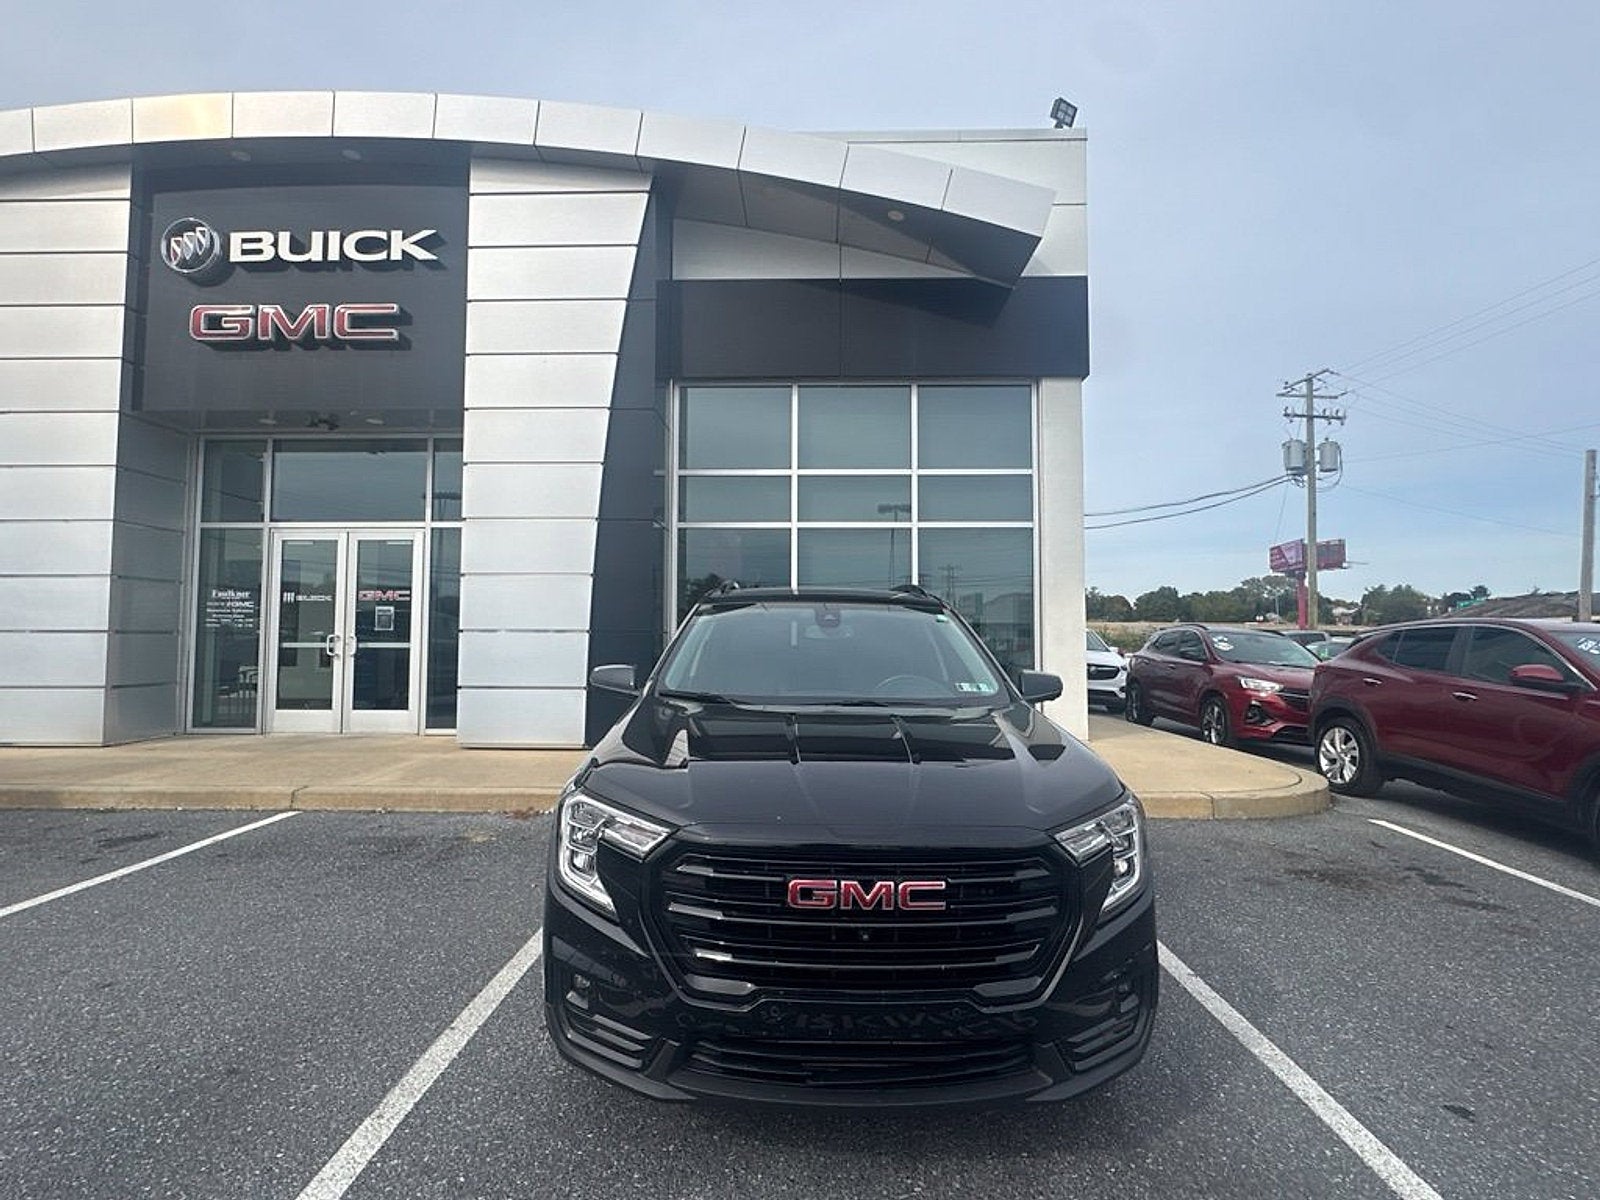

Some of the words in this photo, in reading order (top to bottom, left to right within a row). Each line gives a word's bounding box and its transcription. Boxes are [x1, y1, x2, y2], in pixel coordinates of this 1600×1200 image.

[229, 229, 438, 263] BUICK
[189, 303, 400, 341] GMC
[212, 589, 251, 598] Faulkner
[358, 590, 411, 601] GMC
[787, 879, 947, 911] GMC
